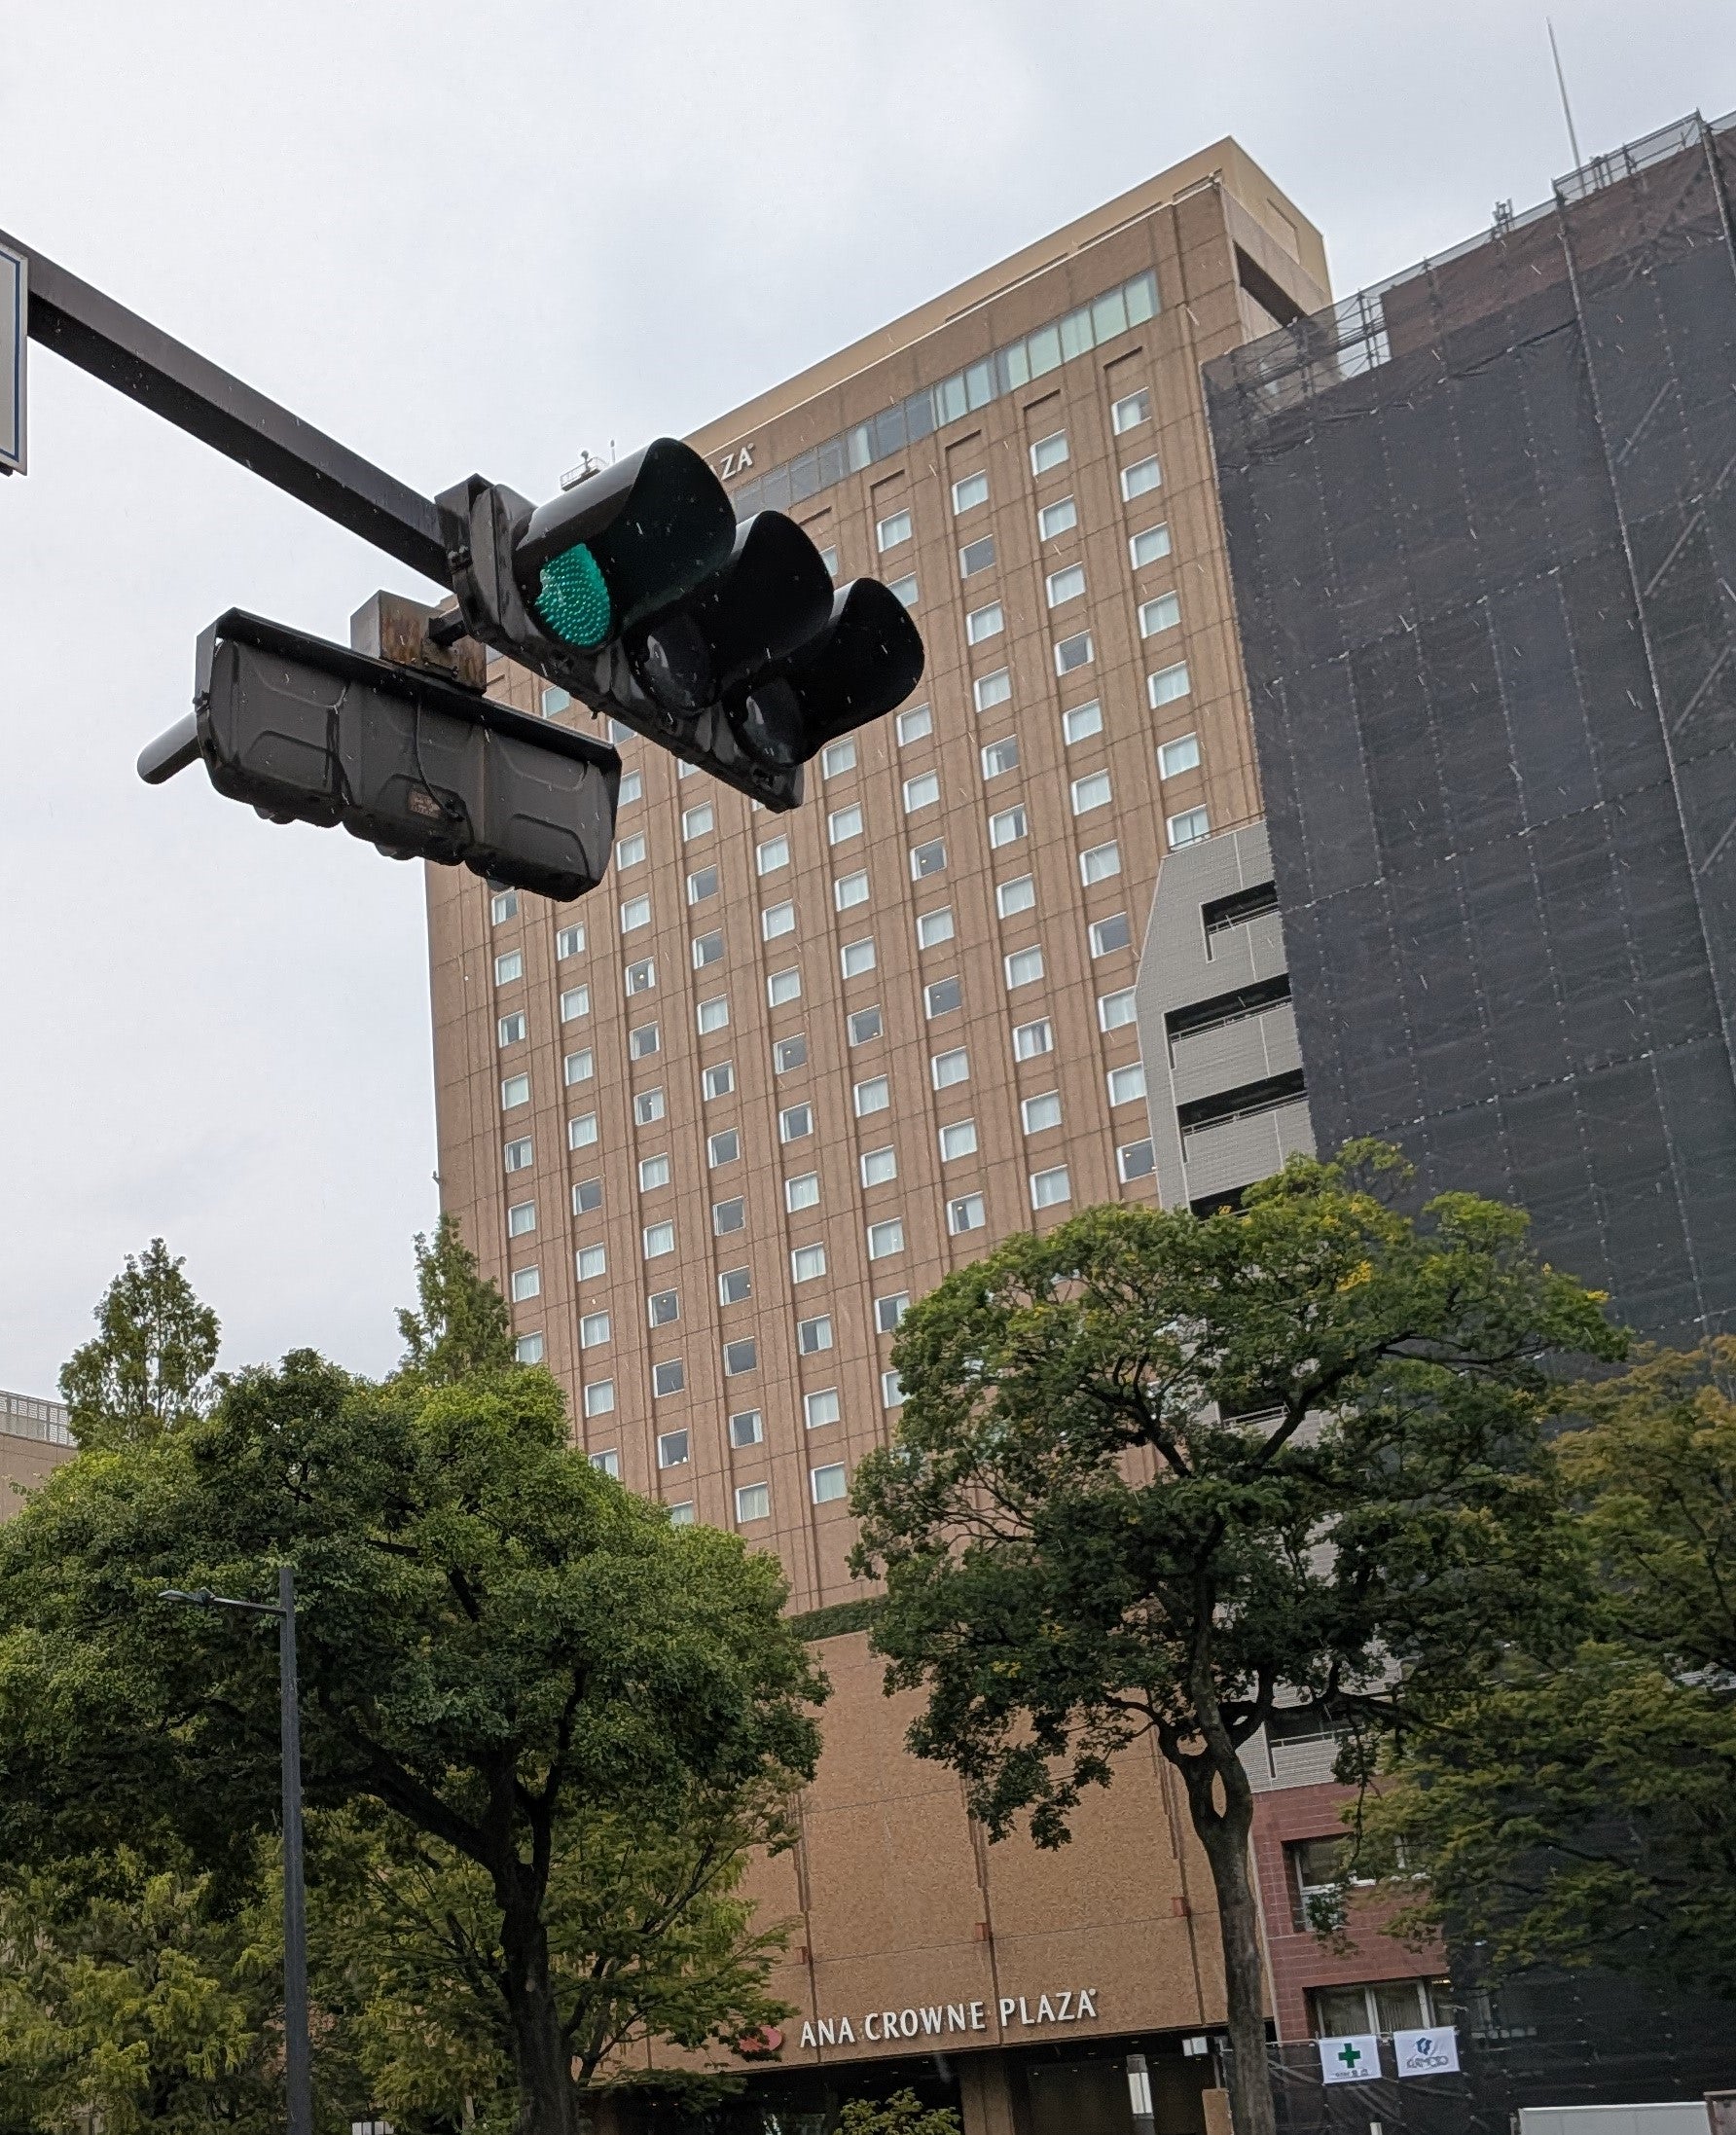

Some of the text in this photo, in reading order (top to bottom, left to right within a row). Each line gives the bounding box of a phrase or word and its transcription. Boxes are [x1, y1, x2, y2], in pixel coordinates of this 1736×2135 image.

[710, 445, 754, 481] ZA
[800, 1988, 1097, 2047] ANA CROWNE PLAZA
